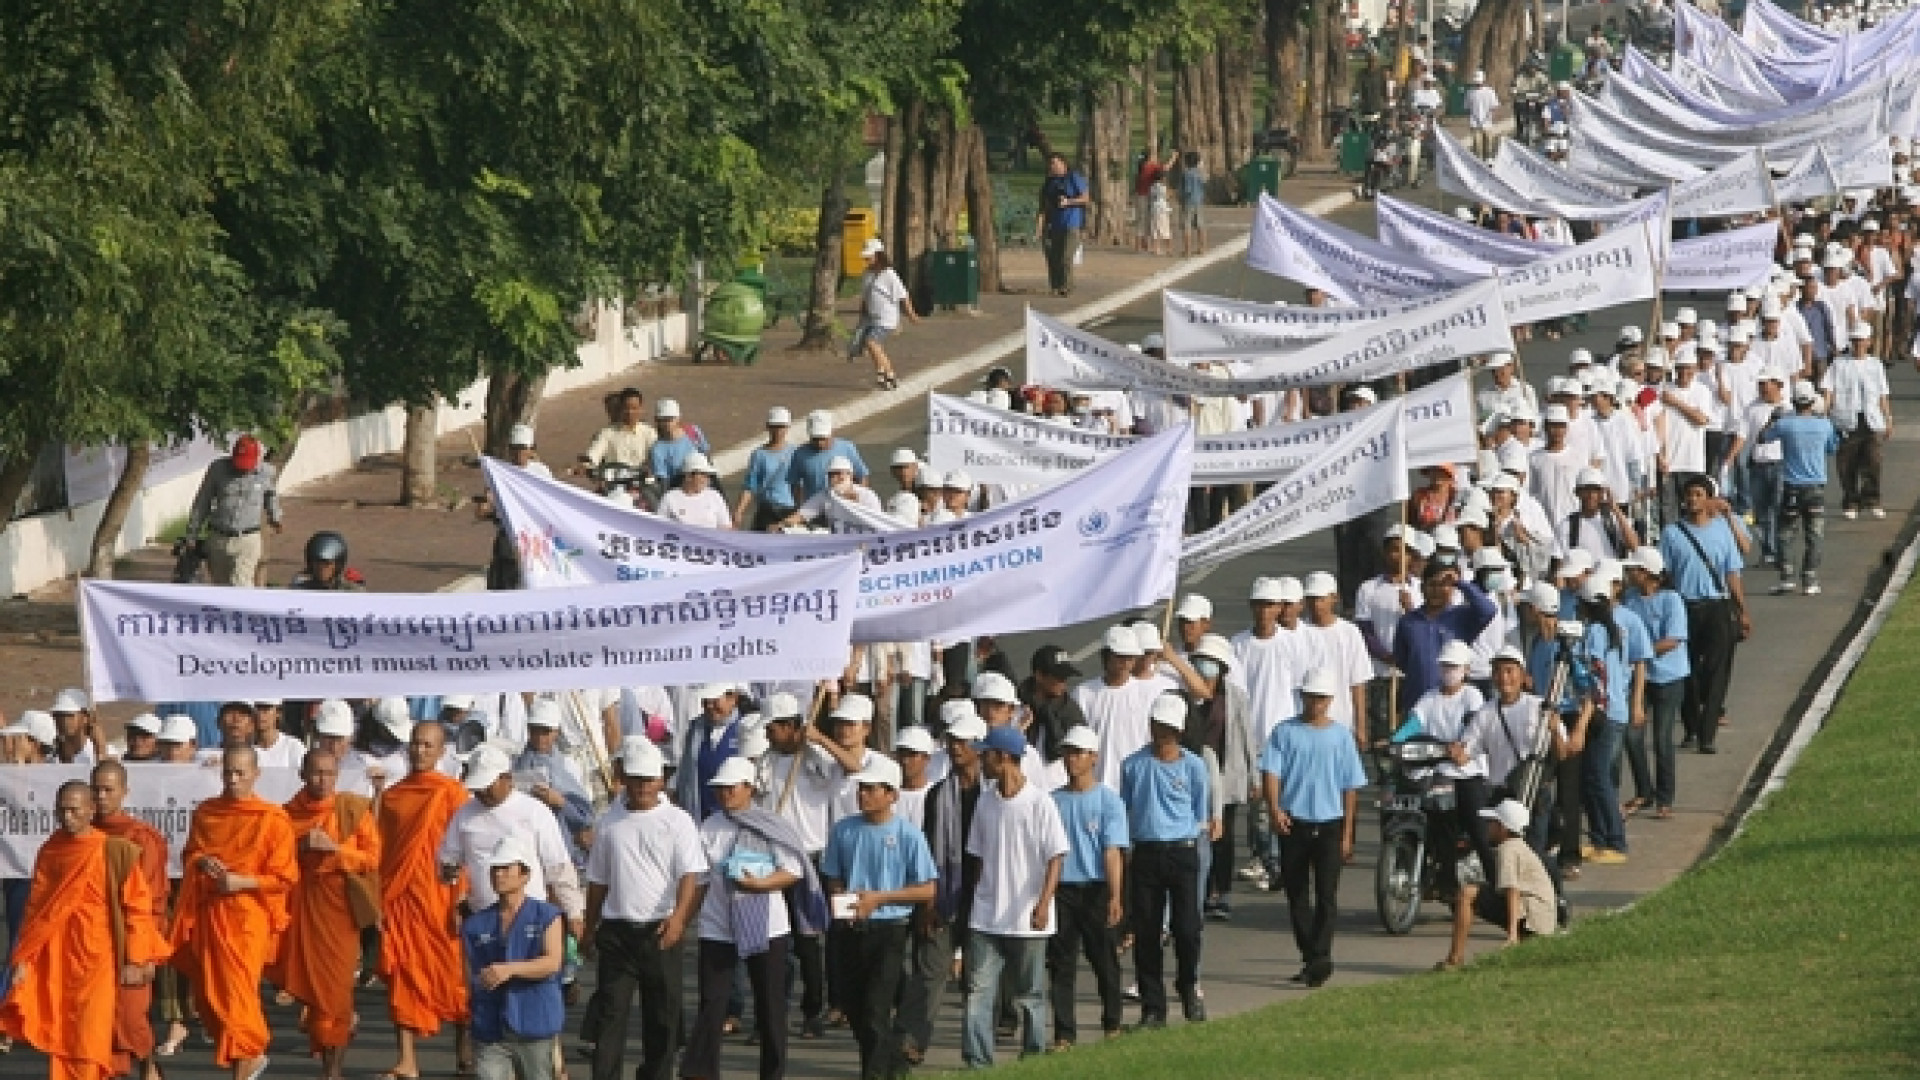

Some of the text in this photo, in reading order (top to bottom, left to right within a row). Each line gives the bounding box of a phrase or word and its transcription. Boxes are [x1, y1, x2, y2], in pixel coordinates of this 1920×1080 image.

[1305, 484, 1357, 513] rights
[858, 545, 1044, 594] SCRIMINATION
[911, 586, 953, 604] 2010
[177, 651, 363, 681] Development
[371, 654, 439, 674] must
[446, 653, 491, 673] not
[499, 648, 594, 671] violate
[601, 645, 693, 668] human
[700, 635, 779, 665] rights
